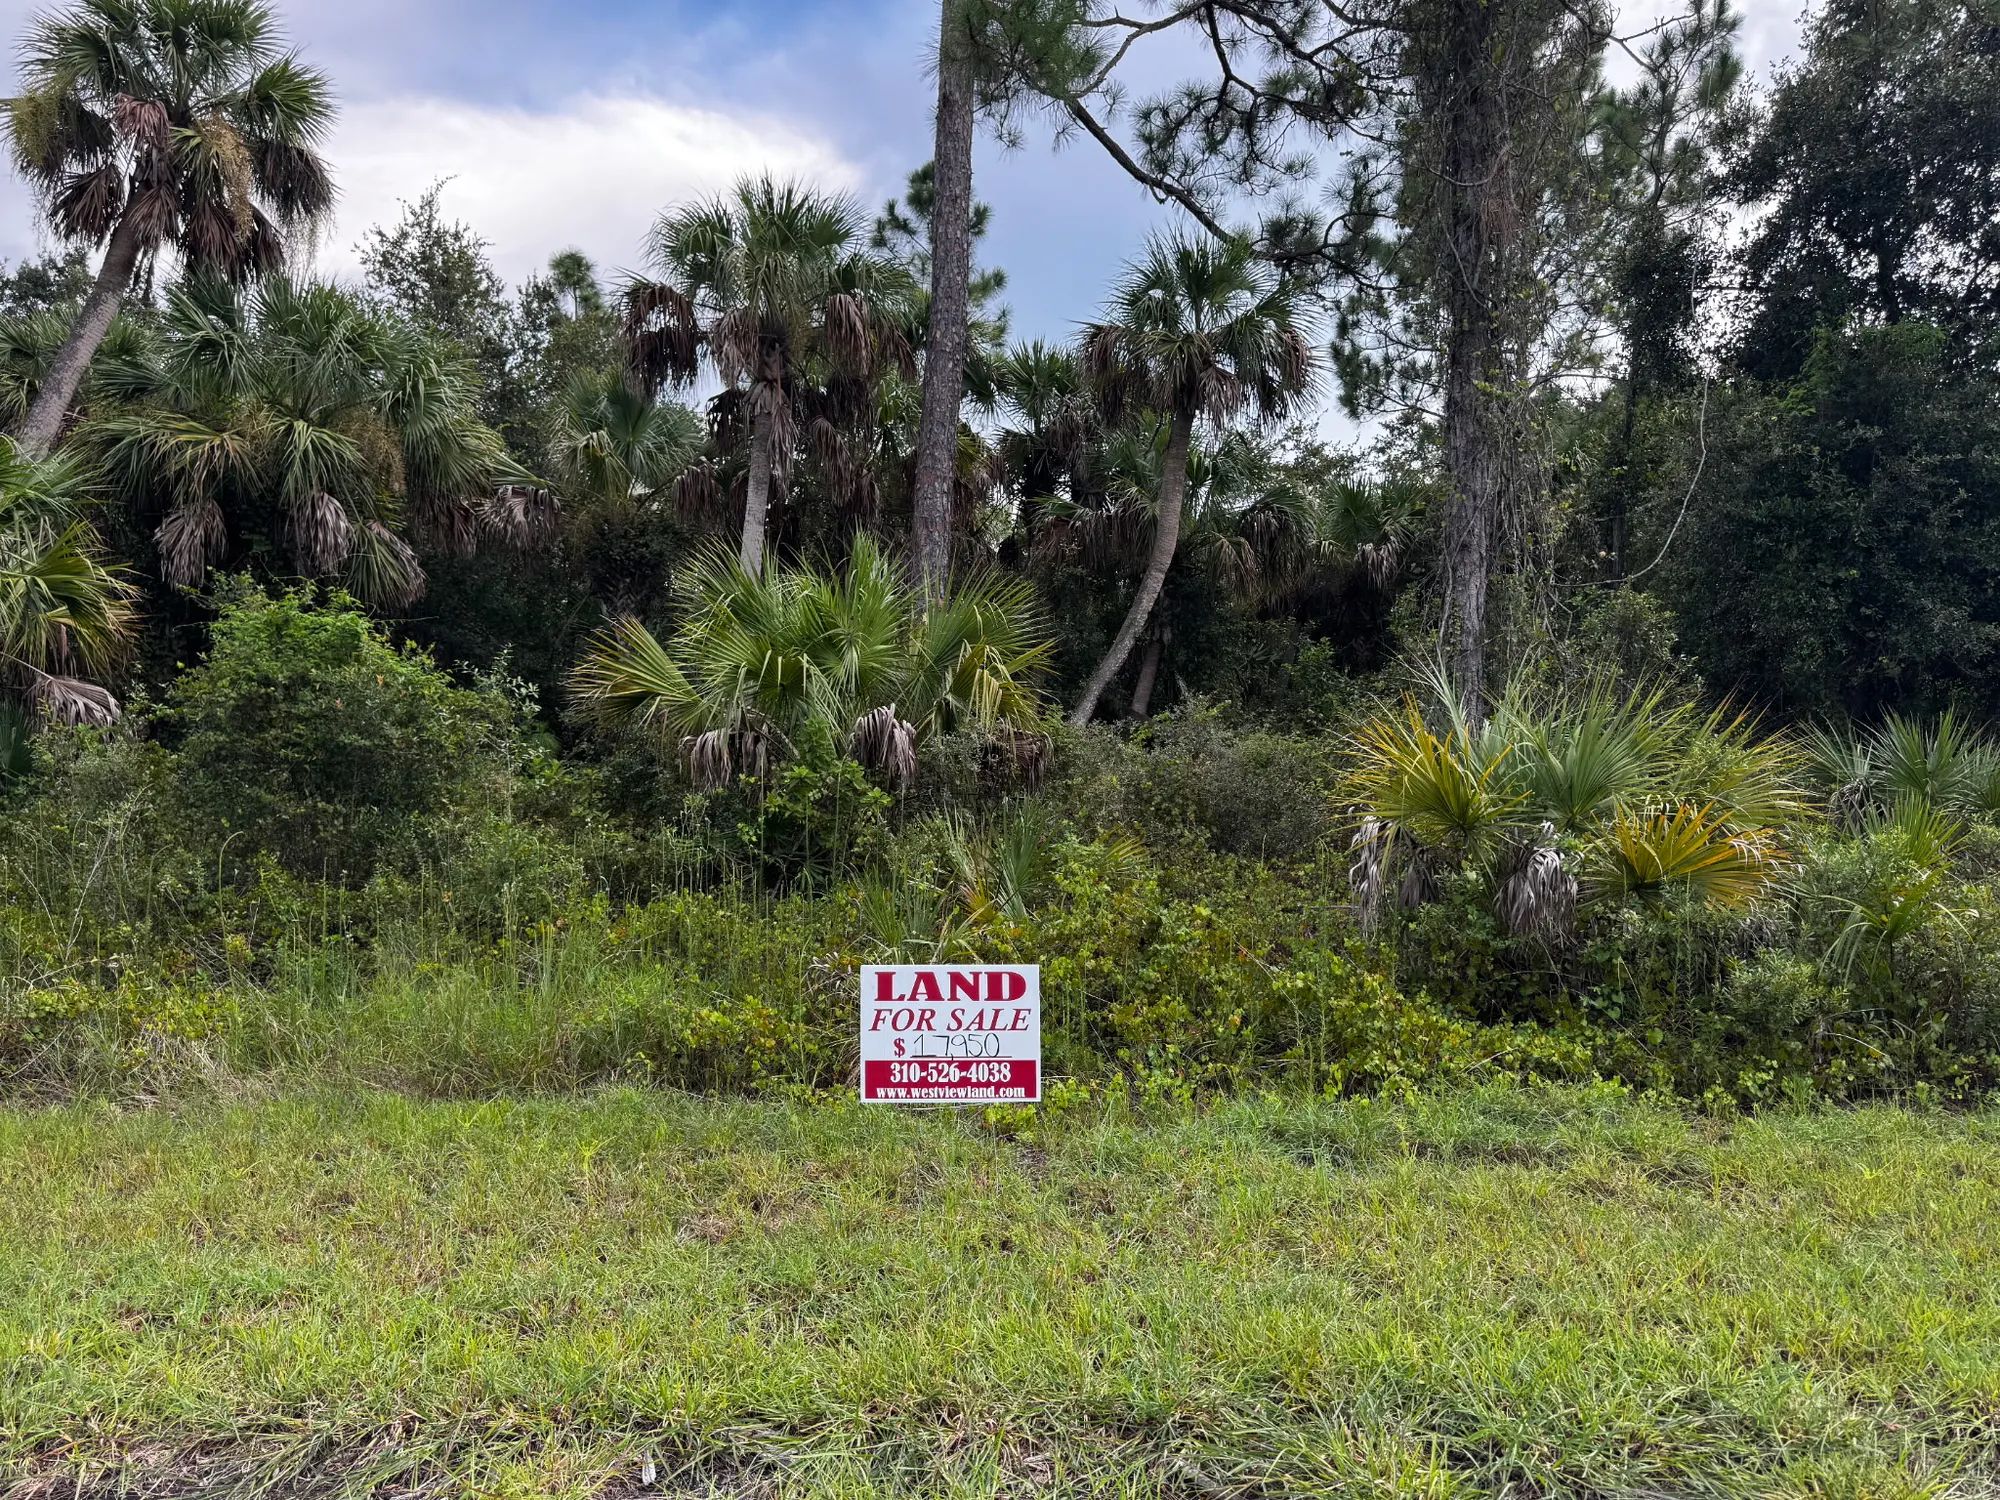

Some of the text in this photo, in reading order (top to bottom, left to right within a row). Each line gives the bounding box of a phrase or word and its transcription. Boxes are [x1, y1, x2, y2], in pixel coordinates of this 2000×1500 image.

[875, 971, 1027, 1002] LAND
[868, 1008, 1031, 1032] FOR SALE
[893, 1036, 906, 1058] $
[890, 1062, 1011, 1083] 310-526-4038
[876, 1085, 1025, 1098] www.westviewland.com
